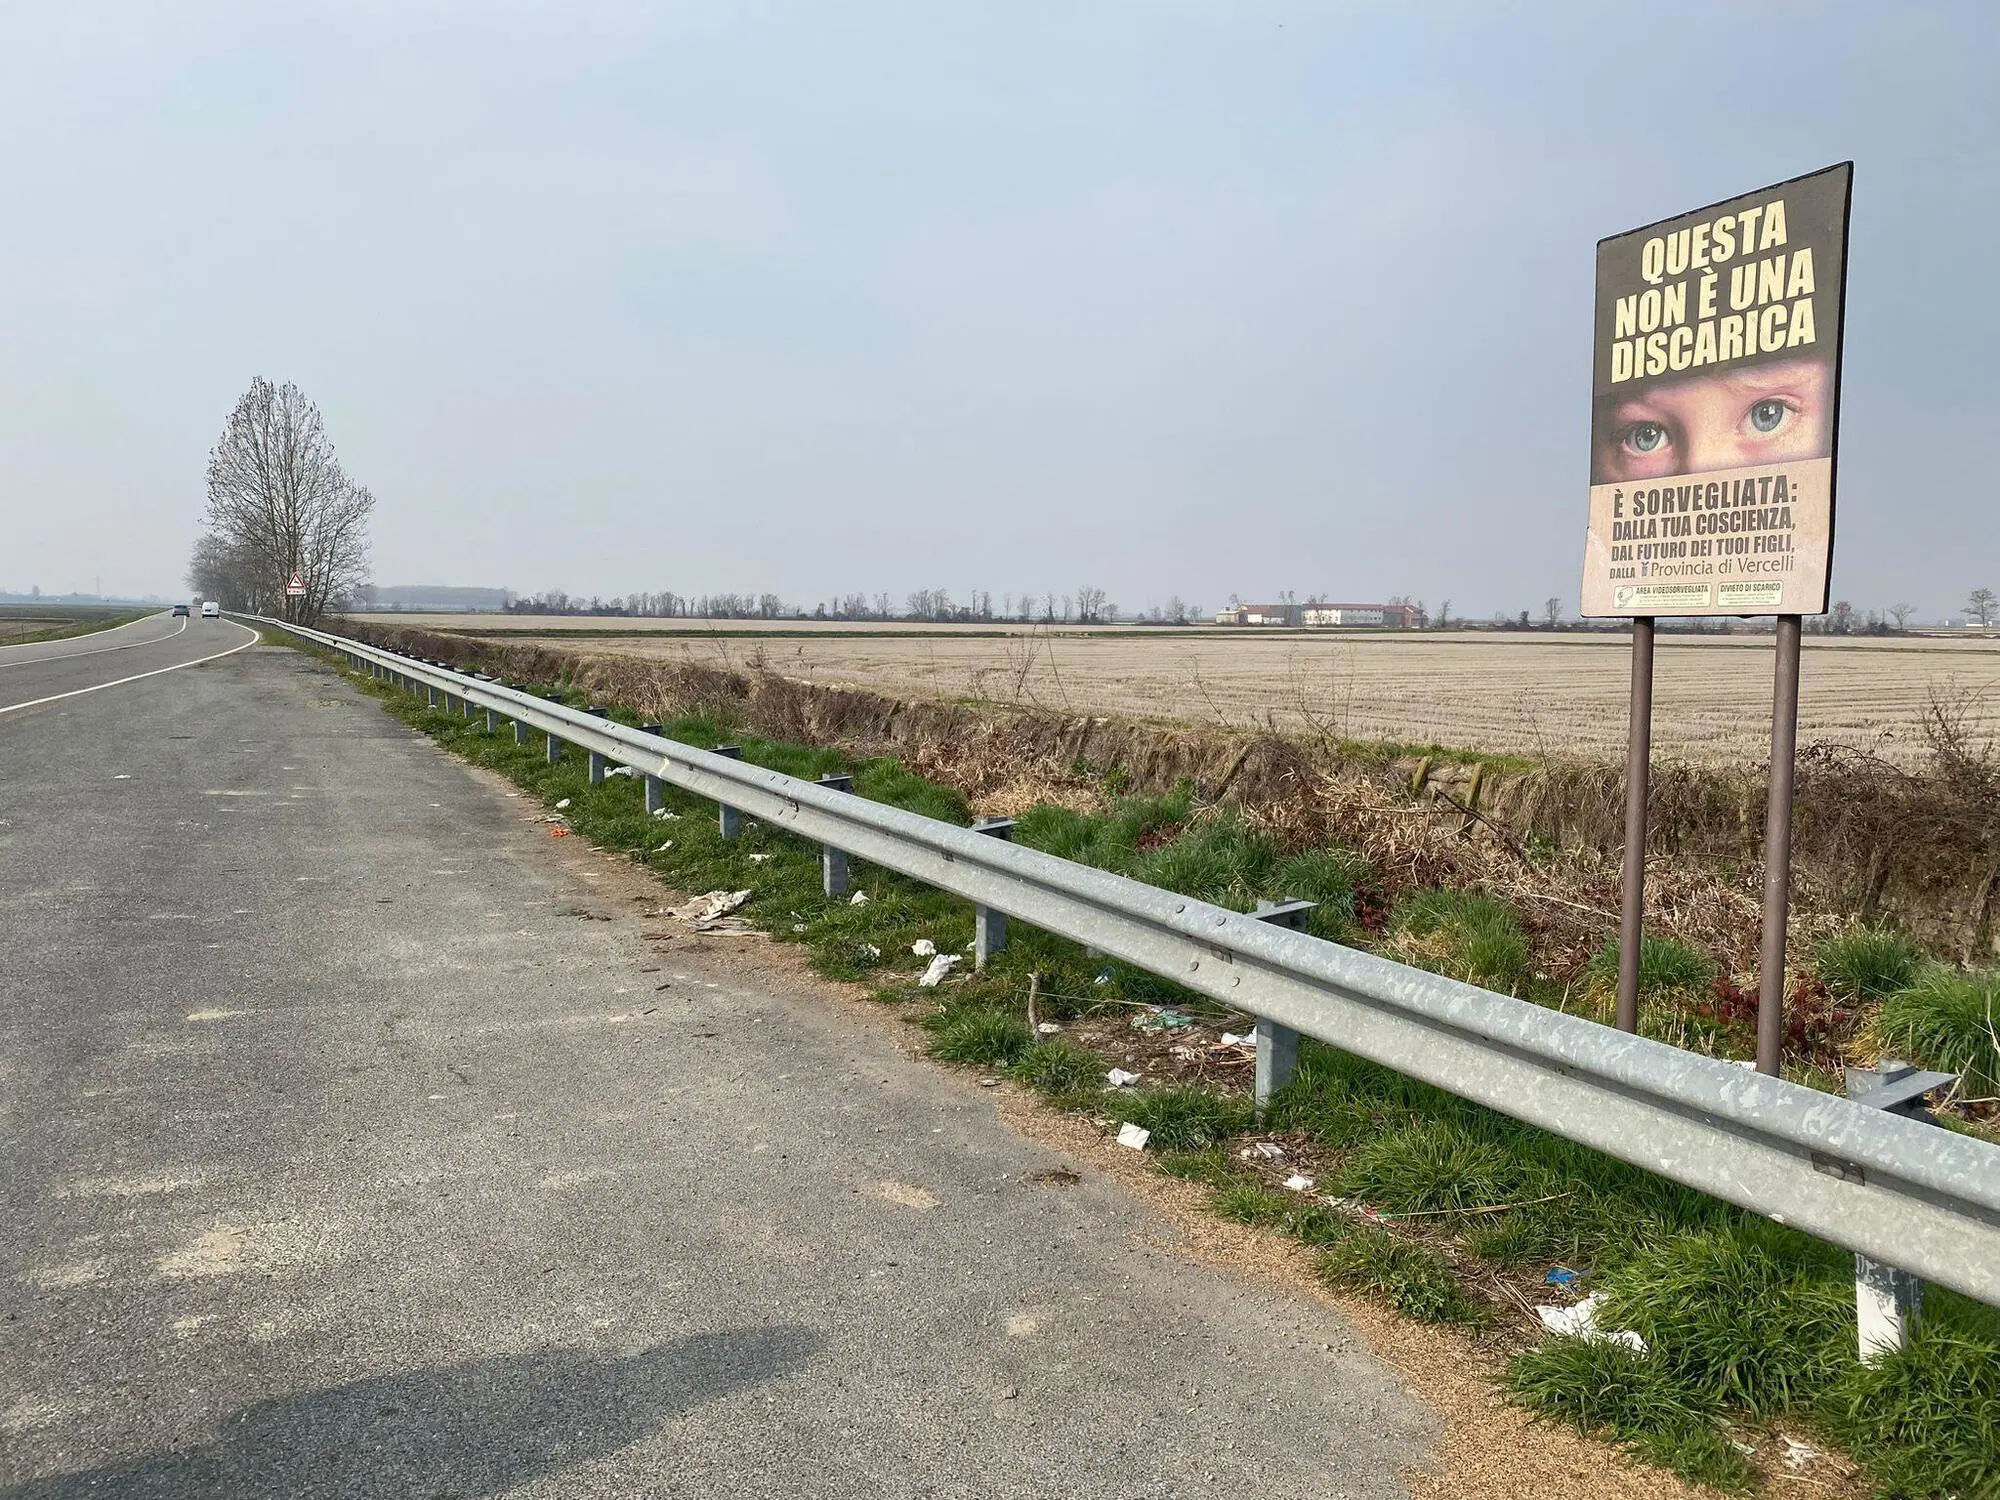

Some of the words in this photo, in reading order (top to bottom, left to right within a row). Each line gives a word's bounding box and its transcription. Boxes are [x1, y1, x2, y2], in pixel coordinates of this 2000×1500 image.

[1642, 200, 1787, 285] QUESTA
[1615, 281, 1687, 339] NON
[1698, 266, 1718, 319] È
[1730, 247, 1815, 311] UNA
[1611, 297, 1816, 384] DISCARICA
[1613, 488, 1623, 518] È
[1633, 475, 1797, 517] SORVEGLIATA:
[1612, 519, 1657, 541] DALLA
[1661, 516, 1692, 538] TUA
[1696, 507, 1796, 536] COSCIENZA,
[1609, 567, 1636, 579] DALLA
[1651, 560, 1713, 577] Provincia
[1718, 559, 1732, 574] di
[1738, 555, 1794, 573] Vercelli
[1611, 545, 1633, 562] DAL
[1637, 541, 1687, 560] FUTURO
[1691, 539, 1712, 557] DEI
[1717, 537, 1750, 556] TUOI
[1754, 534, 1795, 554] FIGLI,
[1720, 584, 1743, 592] DIVIETO
[1745, 583, 1752, 592] DI
[1752, 582, 1781, 592] SCARICO
